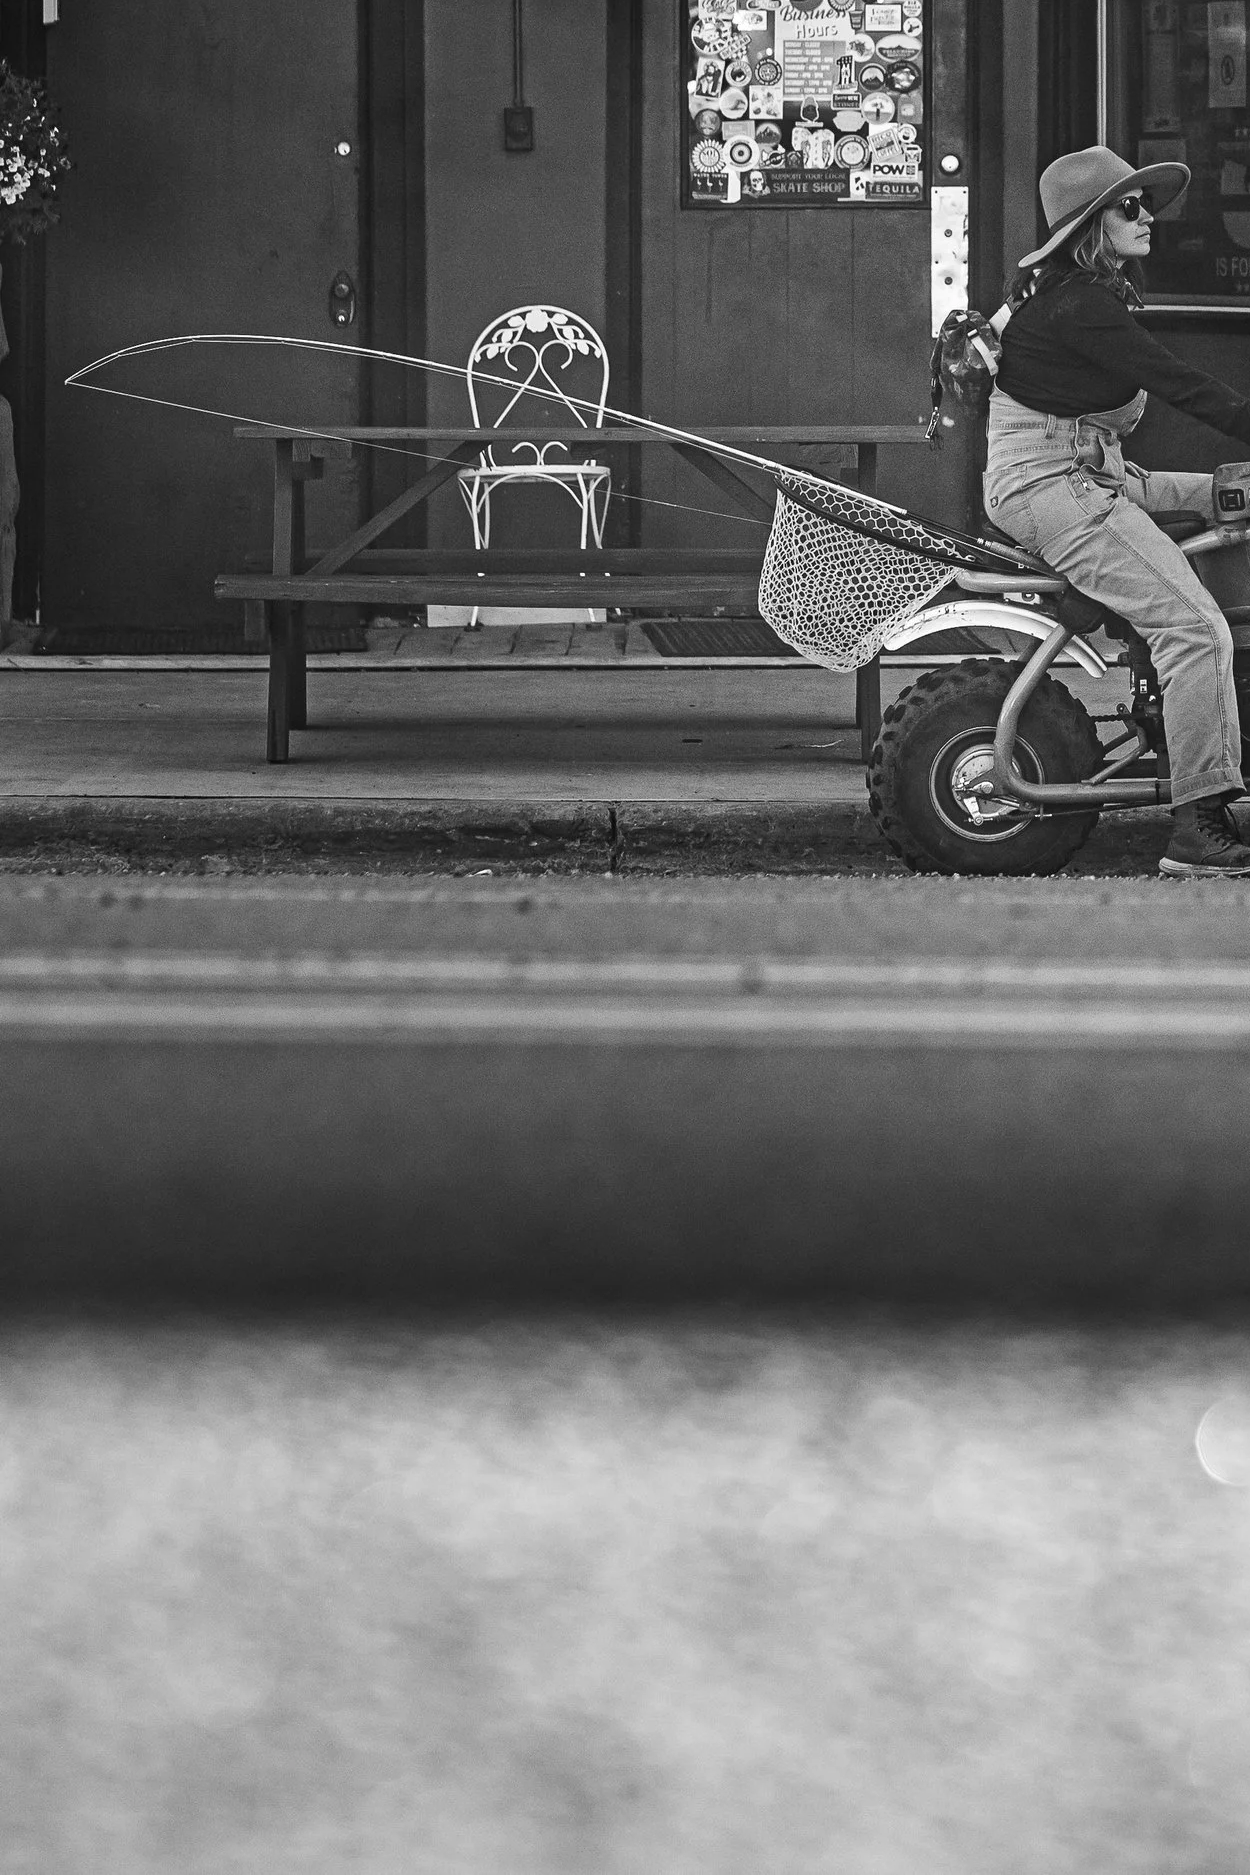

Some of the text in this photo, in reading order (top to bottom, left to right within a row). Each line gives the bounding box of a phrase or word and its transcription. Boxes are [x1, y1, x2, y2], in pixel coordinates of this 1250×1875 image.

[780, 6, 846, 22] Business
[796, 24, 838, 39] Hours
[872, 165, 905, 175] POW
[772, 182, 845, 193] SKATE SHOP
[868, 184, 920, 194] TEQUILA
[1215, 257, 1228, 277] IS
